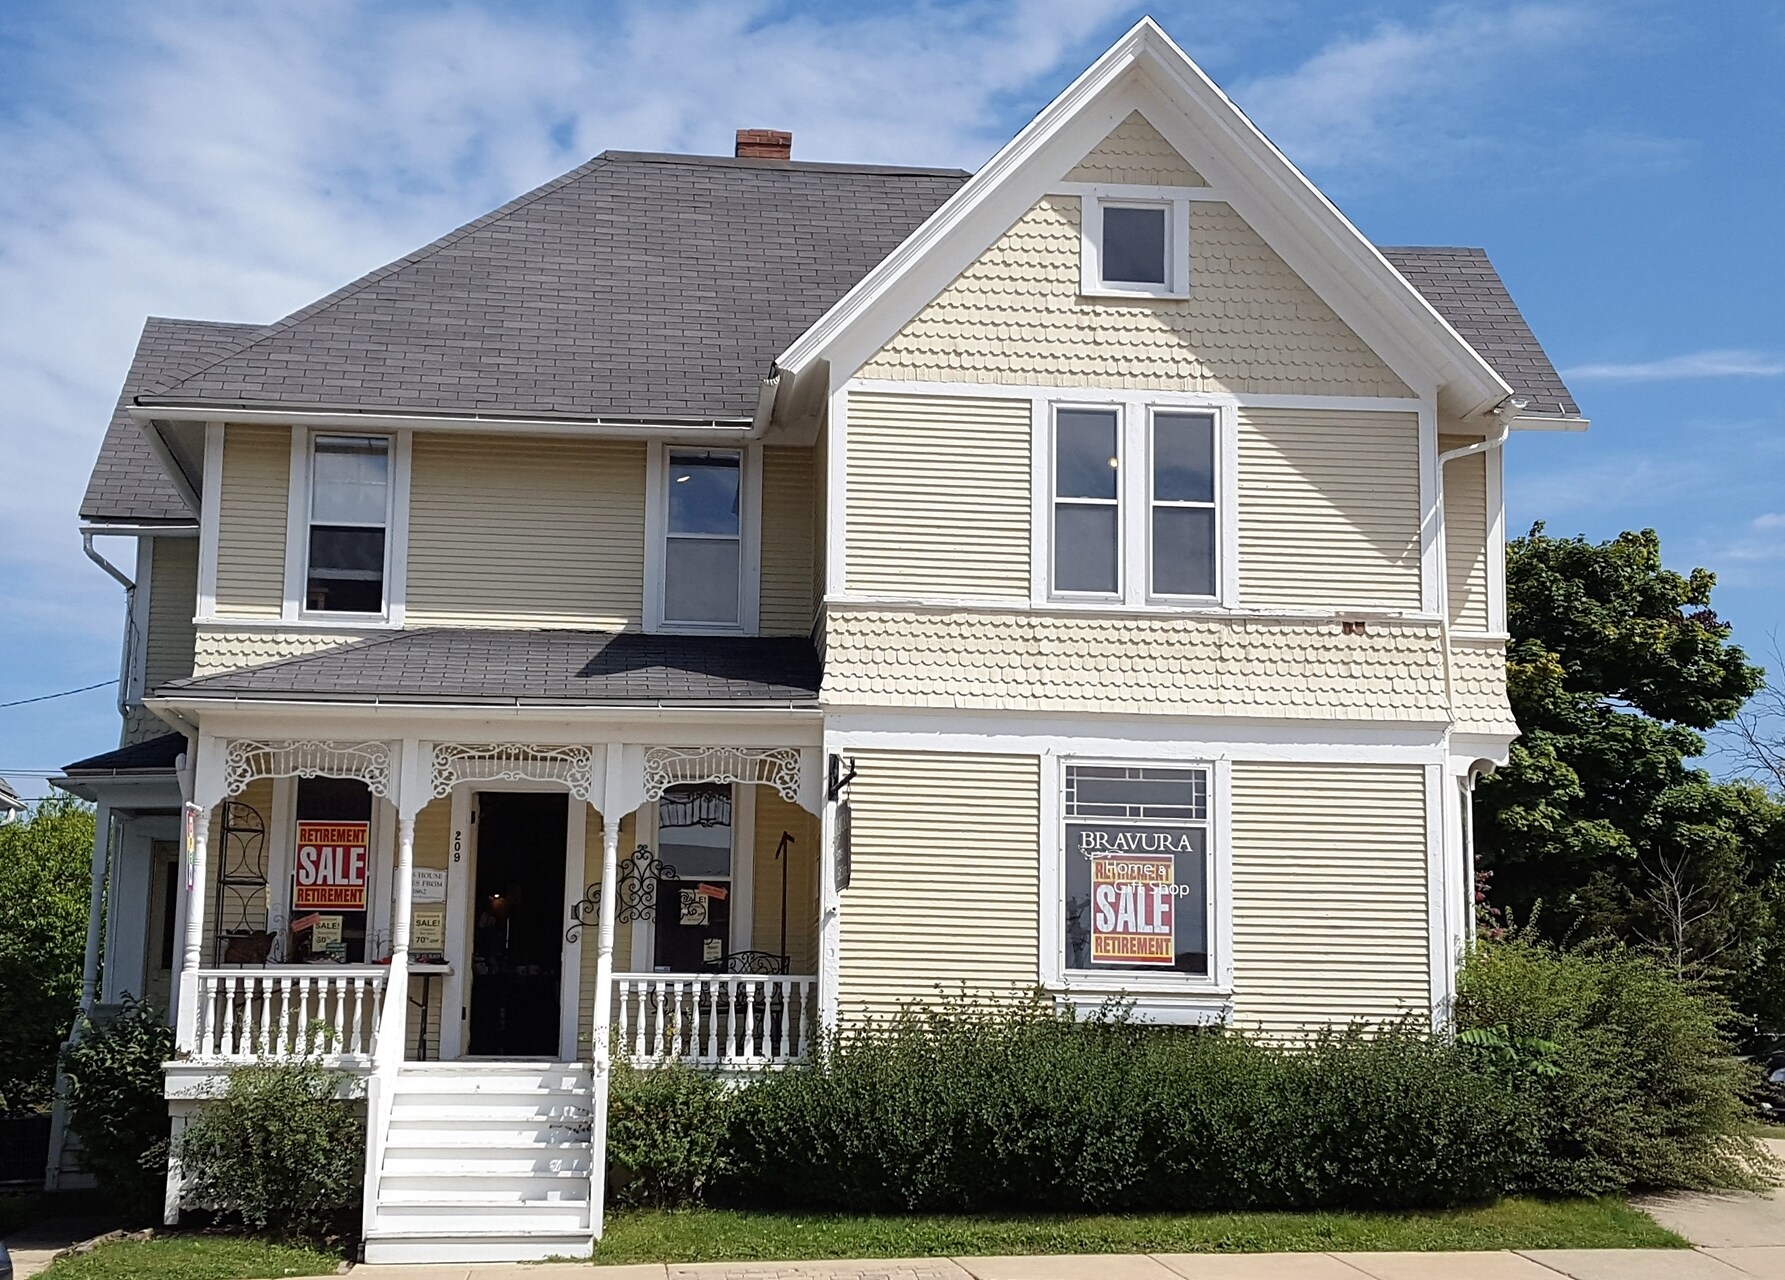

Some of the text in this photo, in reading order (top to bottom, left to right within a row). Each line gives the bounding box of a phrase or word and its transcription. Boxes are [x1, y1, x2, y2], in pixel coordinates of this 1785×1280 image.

[300, 828, 367, 843] RETIREMENT
[1080, 831, 1193, 852] BRAVURA
[299, 846, 364, 885] SALE
[1105, 860, 1154, 875] Home
[297, 888, 364, 902] RETIREMENT
[1149, 880, 1190, 898] Shop
[1096, 884, 1170, 933] SALE
[316, 922, 340, 930] SALE!
[1095, 936, 1171, 956] RETIREMENT
